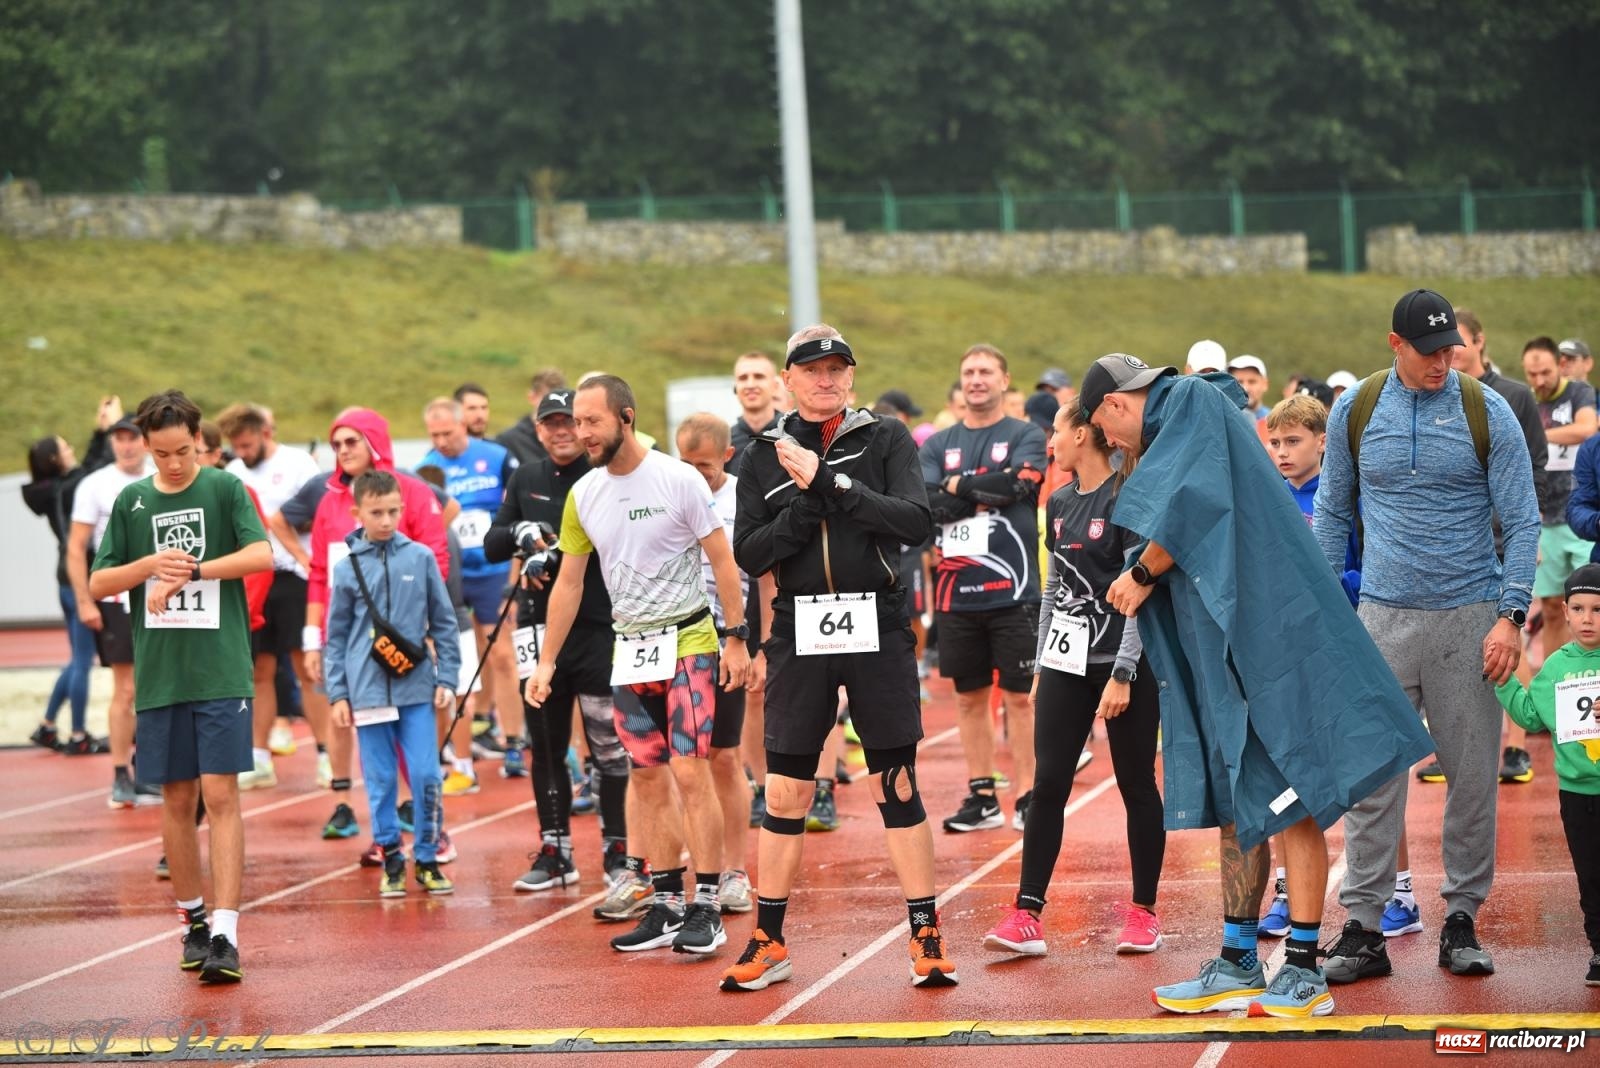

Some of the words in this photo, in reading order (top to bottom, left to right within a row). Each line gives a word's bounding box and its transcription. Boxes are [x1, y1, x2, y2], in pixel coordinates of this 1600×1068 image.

[157, 513, 200, 528] KOSZALIN
[628, 506, 652, 521] UTA
[949, 524, 970, 542] 48
[819, 611, 854, 636] 64
[1049, 628, 1071, 654] 76
[374, 635, 415, 673] EASY
[633, 646, 660, 668] 54
[1576, 696, 1600, 721] 9
[1293, 986, 1317, 1002] HOKA
